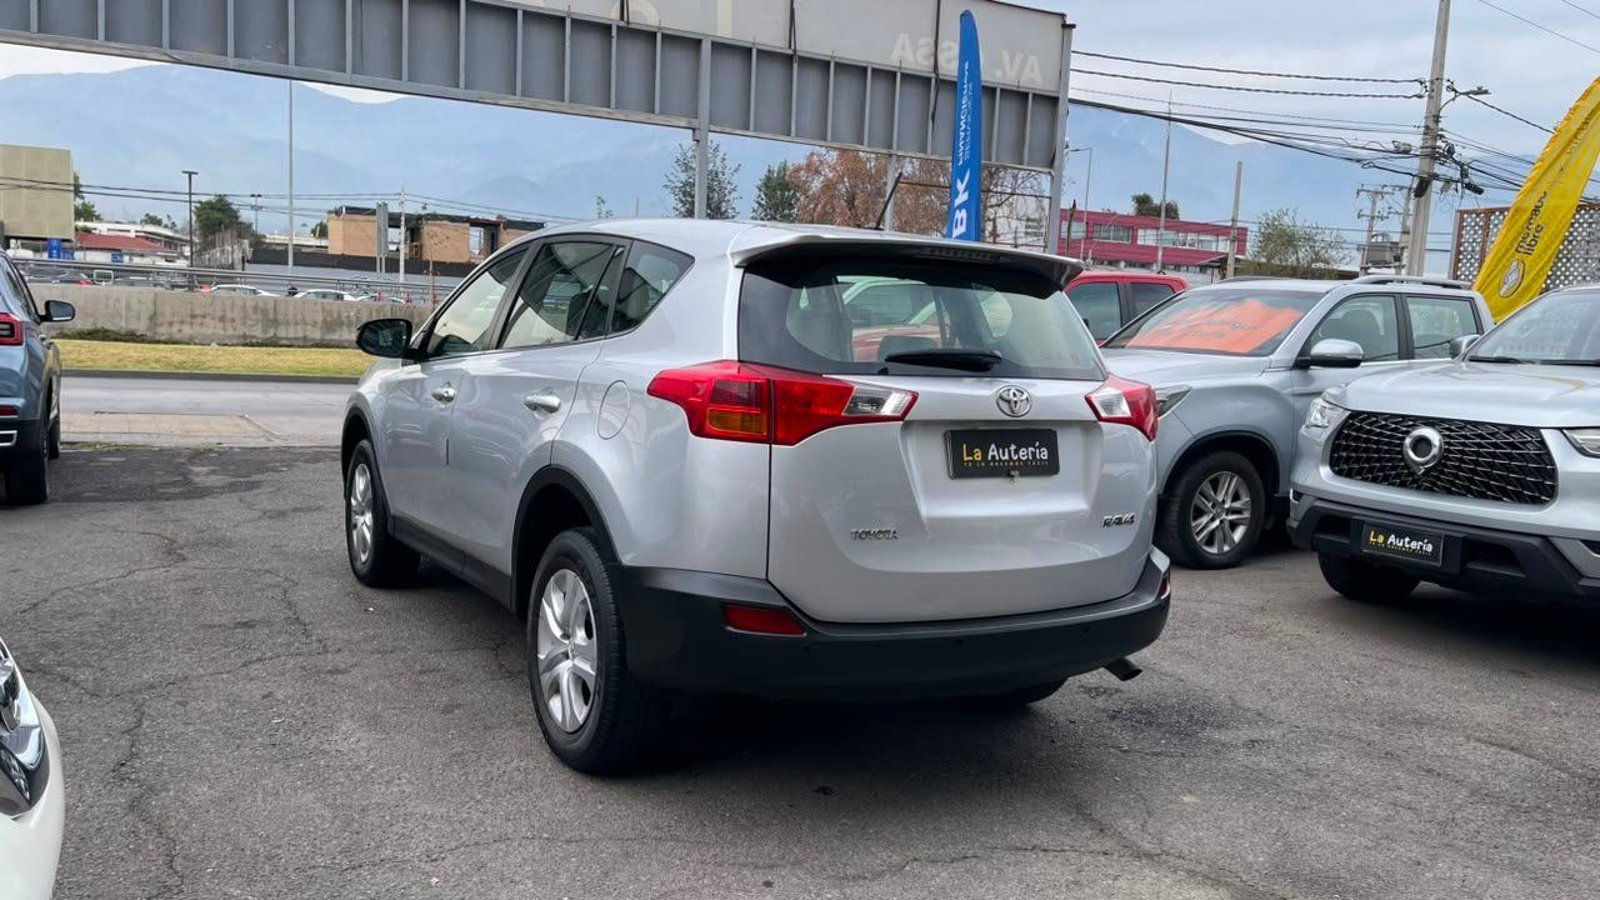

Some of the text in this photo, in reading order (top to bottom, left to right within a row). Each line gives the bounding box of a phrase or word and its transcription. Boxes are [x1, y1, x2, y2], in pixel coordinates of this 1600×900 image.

[952, 168, 970, 239] BK
[1523, 223, 1544, 255] libre
[962, 442, 1049, 461] La Autería
[1103, 512, 1135, 527] RAV4
[850, 528, 898, 541] TOYOTA
[1369, 530, 1384, 544] La
[1387, 534, 1433, 552] Autería
